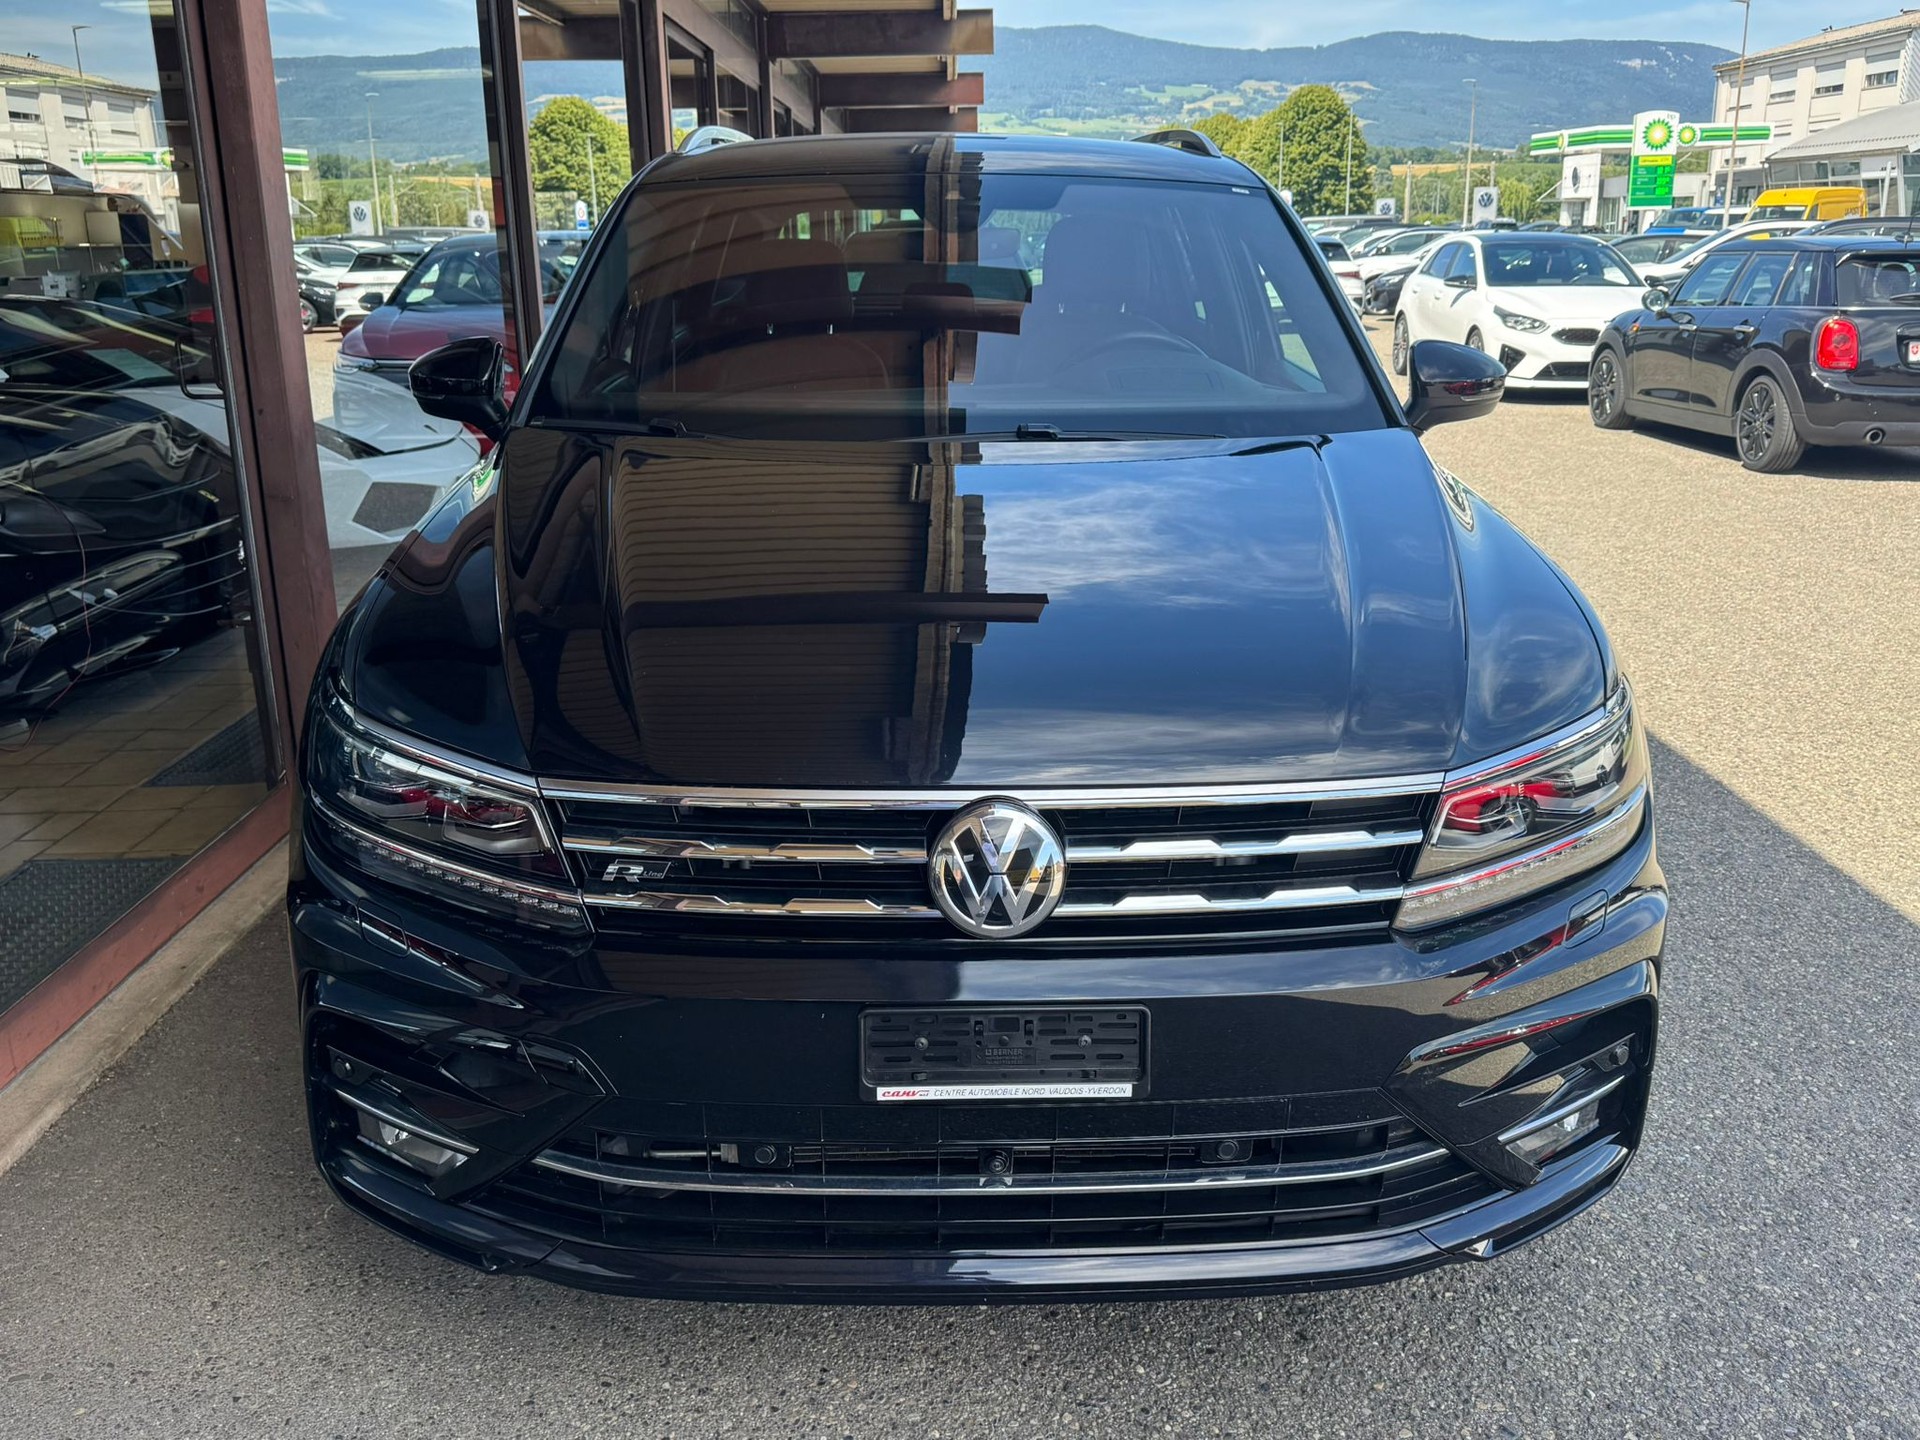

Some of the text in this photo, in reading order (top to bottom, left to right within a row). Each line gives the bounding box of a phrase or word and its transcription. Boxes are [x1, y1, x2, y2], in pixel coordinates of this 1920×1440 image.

[602, 863, 644, 883] R
[993, 1048, 1024, 1056] BERNER
[934, 1088, 967, 1097] CENTRE
[968, 1087, 1020, 1097] AUTOMOBILE
[1021, 1087, 1046, 1096] NORD
